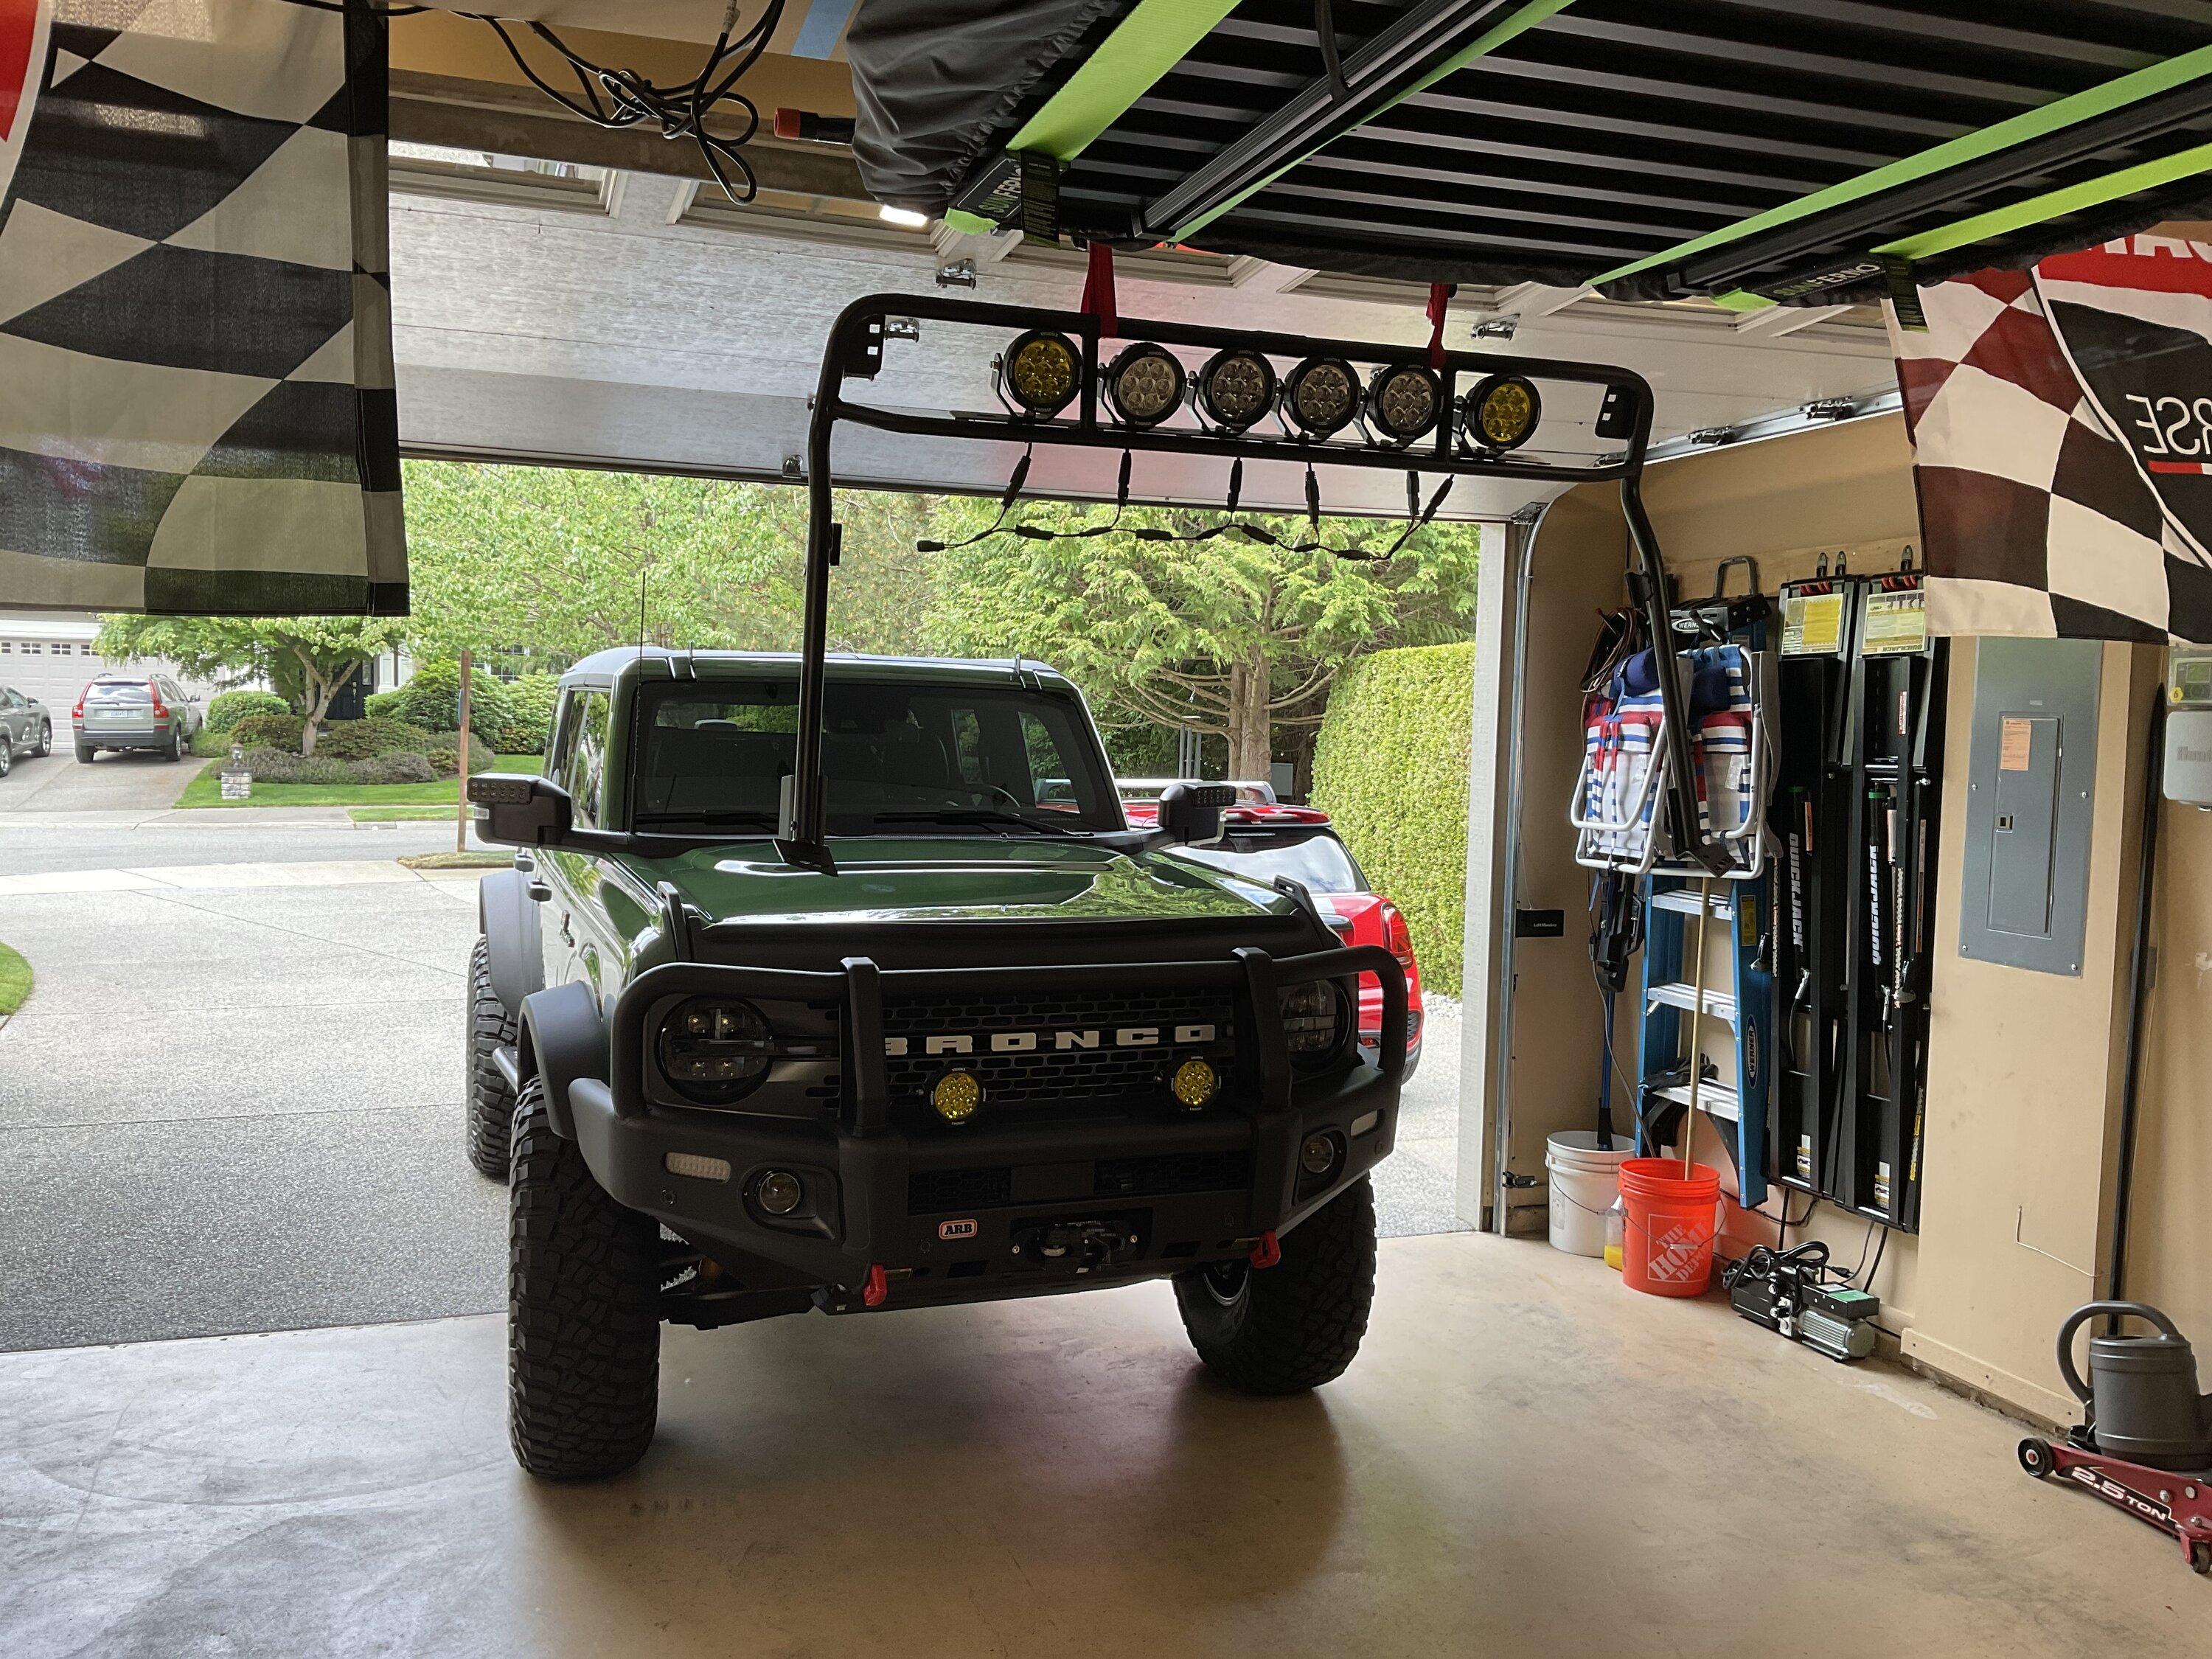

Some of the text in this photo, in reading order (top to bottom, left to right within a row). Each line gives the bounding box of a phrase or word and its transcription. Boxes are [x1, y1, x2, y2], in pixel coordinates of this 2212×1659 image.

[978, 168, 1021, 213] SUNFER
[1773, 264, 1880, 296] SUNFERNO
[1679, 621, 1700, 629] WERN
[1790, 832, 1804, 953] QUICKJACK
[1870, 844, 1881, 965] QUICKJACK
[1748, 1029, 1756, 1074] WERNER
[944, 1222, 973, 1236] ARB
[1649, 1222, 1709, 1280] HOM
[1656, 1224, 1686, 1249] THE
[2071, 1466, 2166, 1521] 2.5 TON
